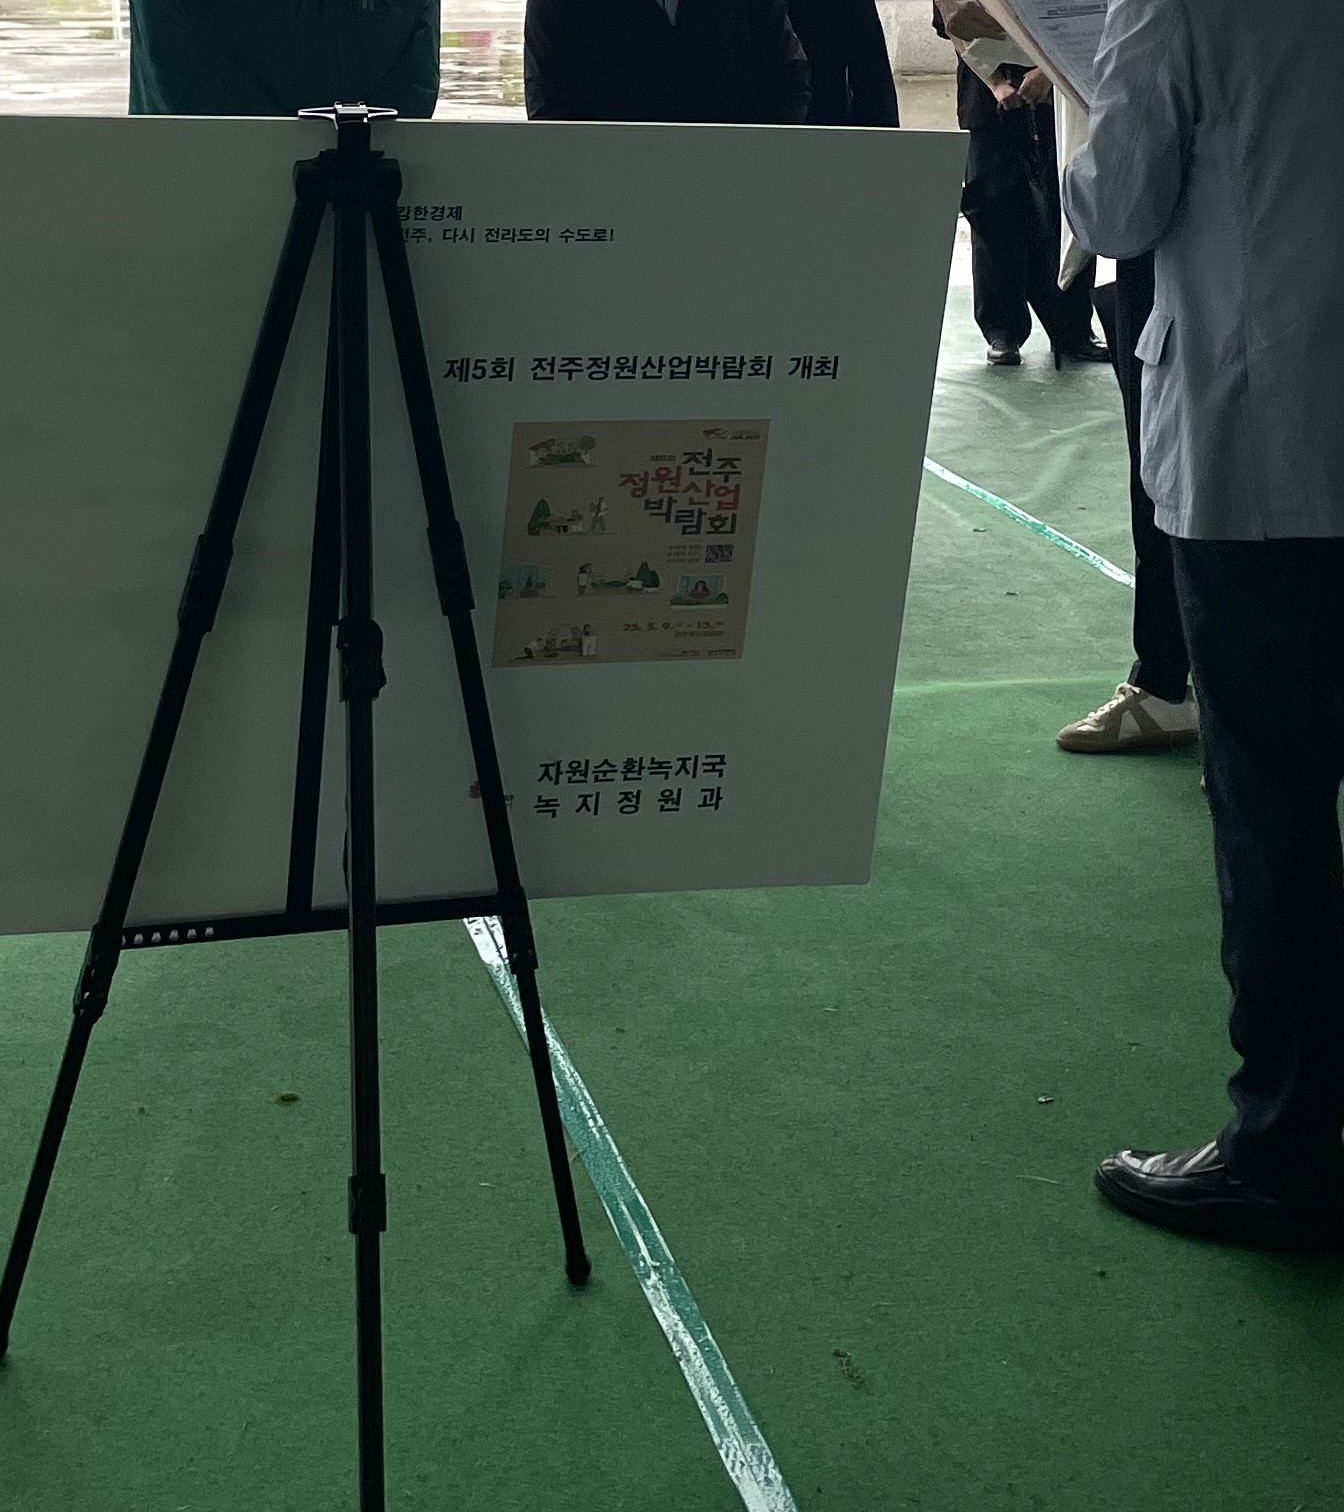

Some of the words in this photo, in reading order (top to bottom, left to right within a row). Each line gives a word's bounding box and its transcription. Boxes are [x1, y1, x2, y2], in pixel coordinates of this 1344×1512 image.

[443, 228, 475, 243] 다시
[485, 228, 549, 243] 전라도의
[558, 227, 615, 244] 수도로!
[444, 356, 516, 383] 제5회
[530, 355, 773, 382] 전주정원산업박람회
[787, 355, 840, 381] 개최
[681, 447, 743, 484] 전주
[643, 495, 737, 536] 박람회
[537, 753, 728, 785] 자원순환녹지국
